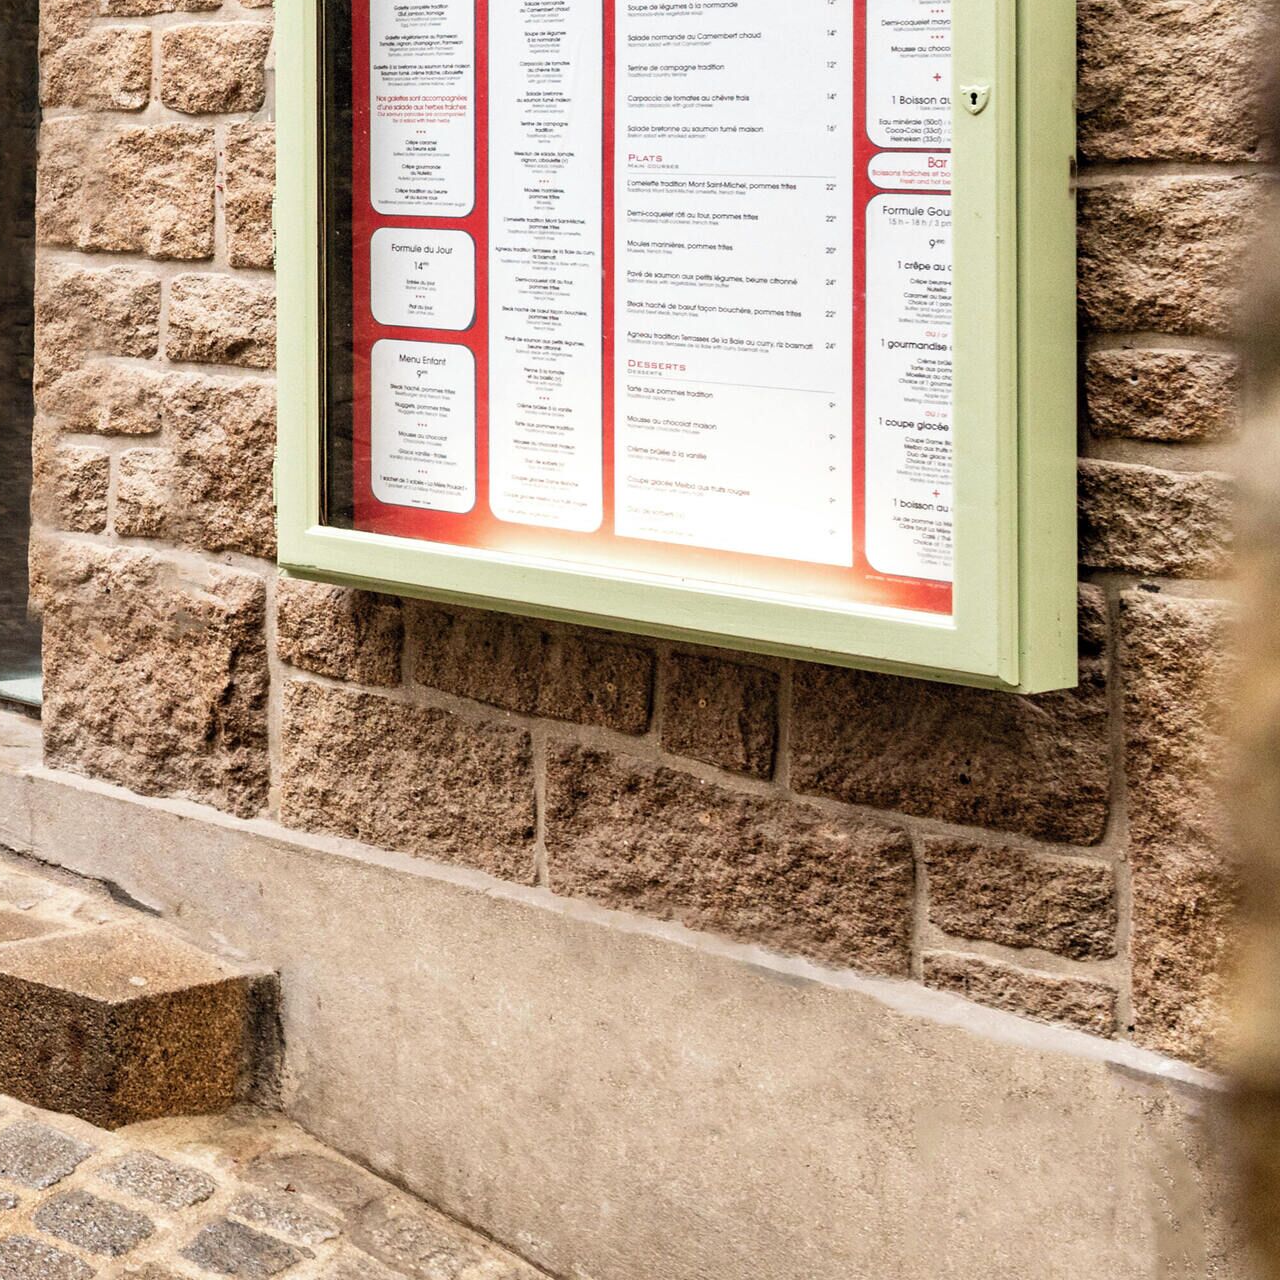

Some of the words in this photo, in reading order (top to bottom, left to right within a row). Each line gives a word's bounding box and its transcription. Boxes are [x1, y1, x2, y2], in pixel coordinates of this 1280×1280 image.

[927, 156, 947, 168] Bar
[882, 205, 924, 215] Formule
[390, 243, 422, 253] Formule
[435, 246, 452, 254] Jour
[897, 260, 901, 268] 1
[903, 261, 931, 271] crêpe
[932, 263, 945, 271] au
[881, 338, 884, 346] 1
[887, 340, 947, 351] gourmandise
[398, 353, 420, 364] Menu
[422, 355, 446, 365] Enfant
[878, 416, 882, 424] 1
[885, 419, 914, 428] coupe
[916, 421, 949, 431] glacée
